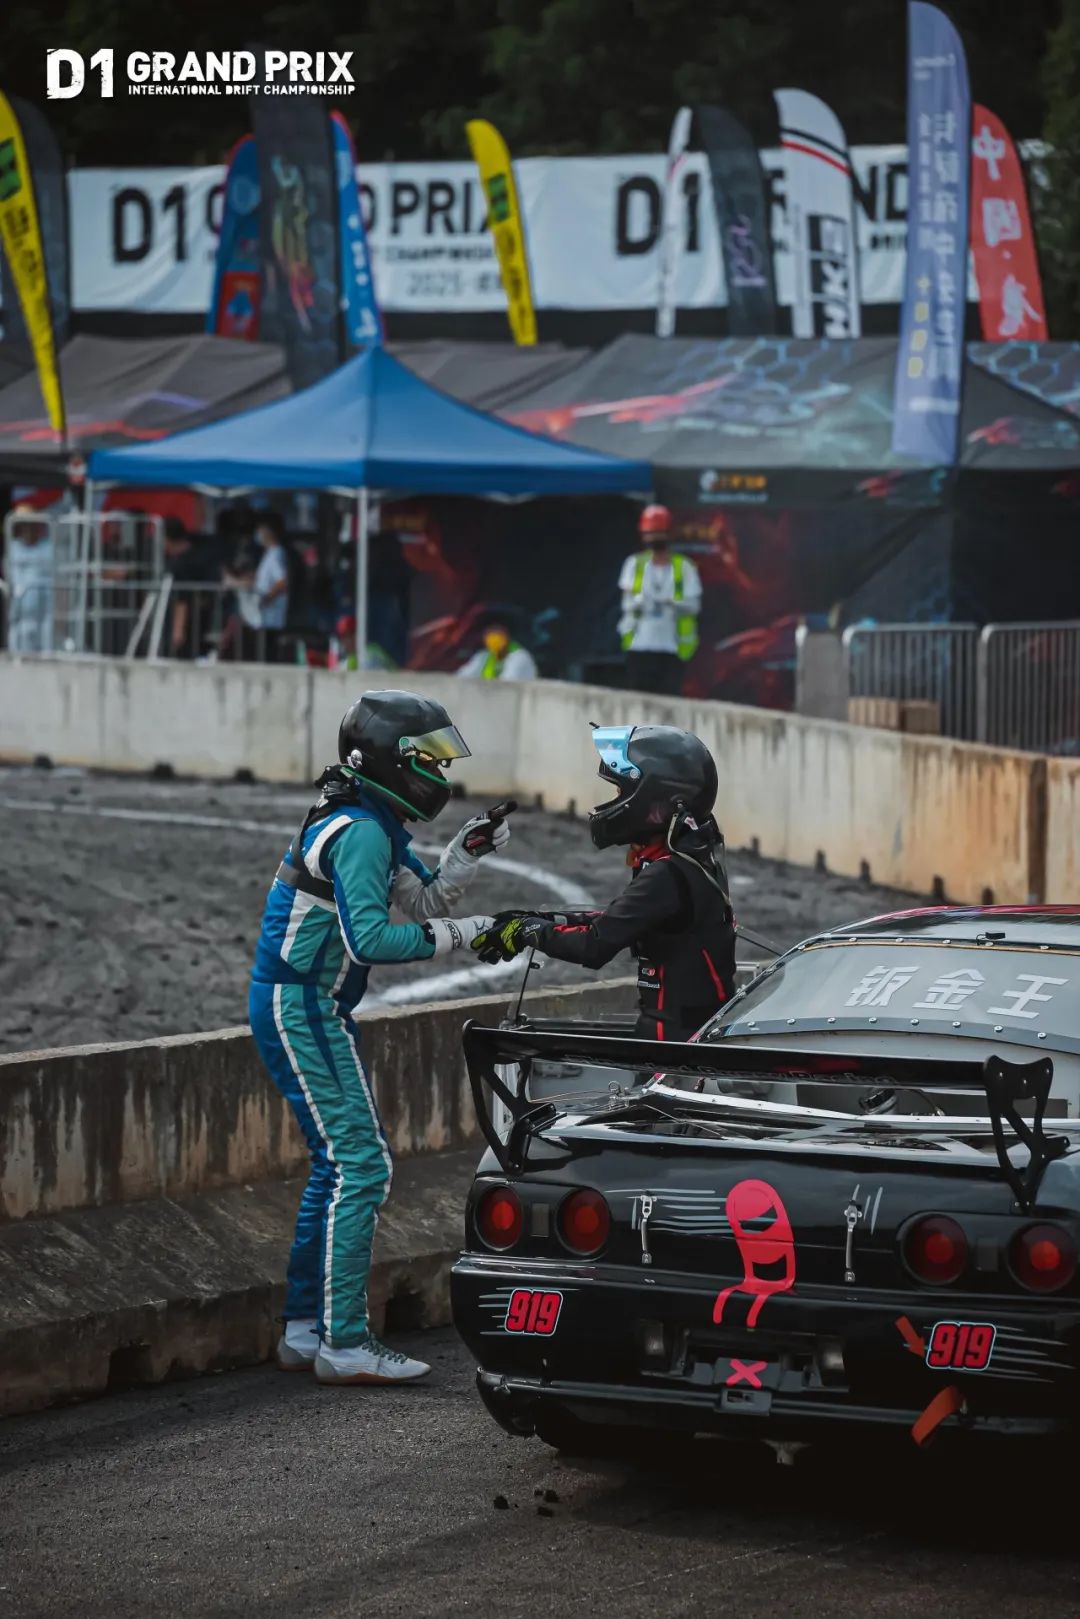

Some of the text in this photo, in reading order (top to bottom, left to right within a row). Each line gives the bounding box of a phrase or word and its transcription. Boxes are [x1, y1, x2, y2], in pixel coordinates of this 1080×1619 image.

[112, 184, 187, 262] D1
[390, 180, 492, 236] PRI
[505, 1289, 562, 1335] 919
[927, 1323, 995, 1370] 919
